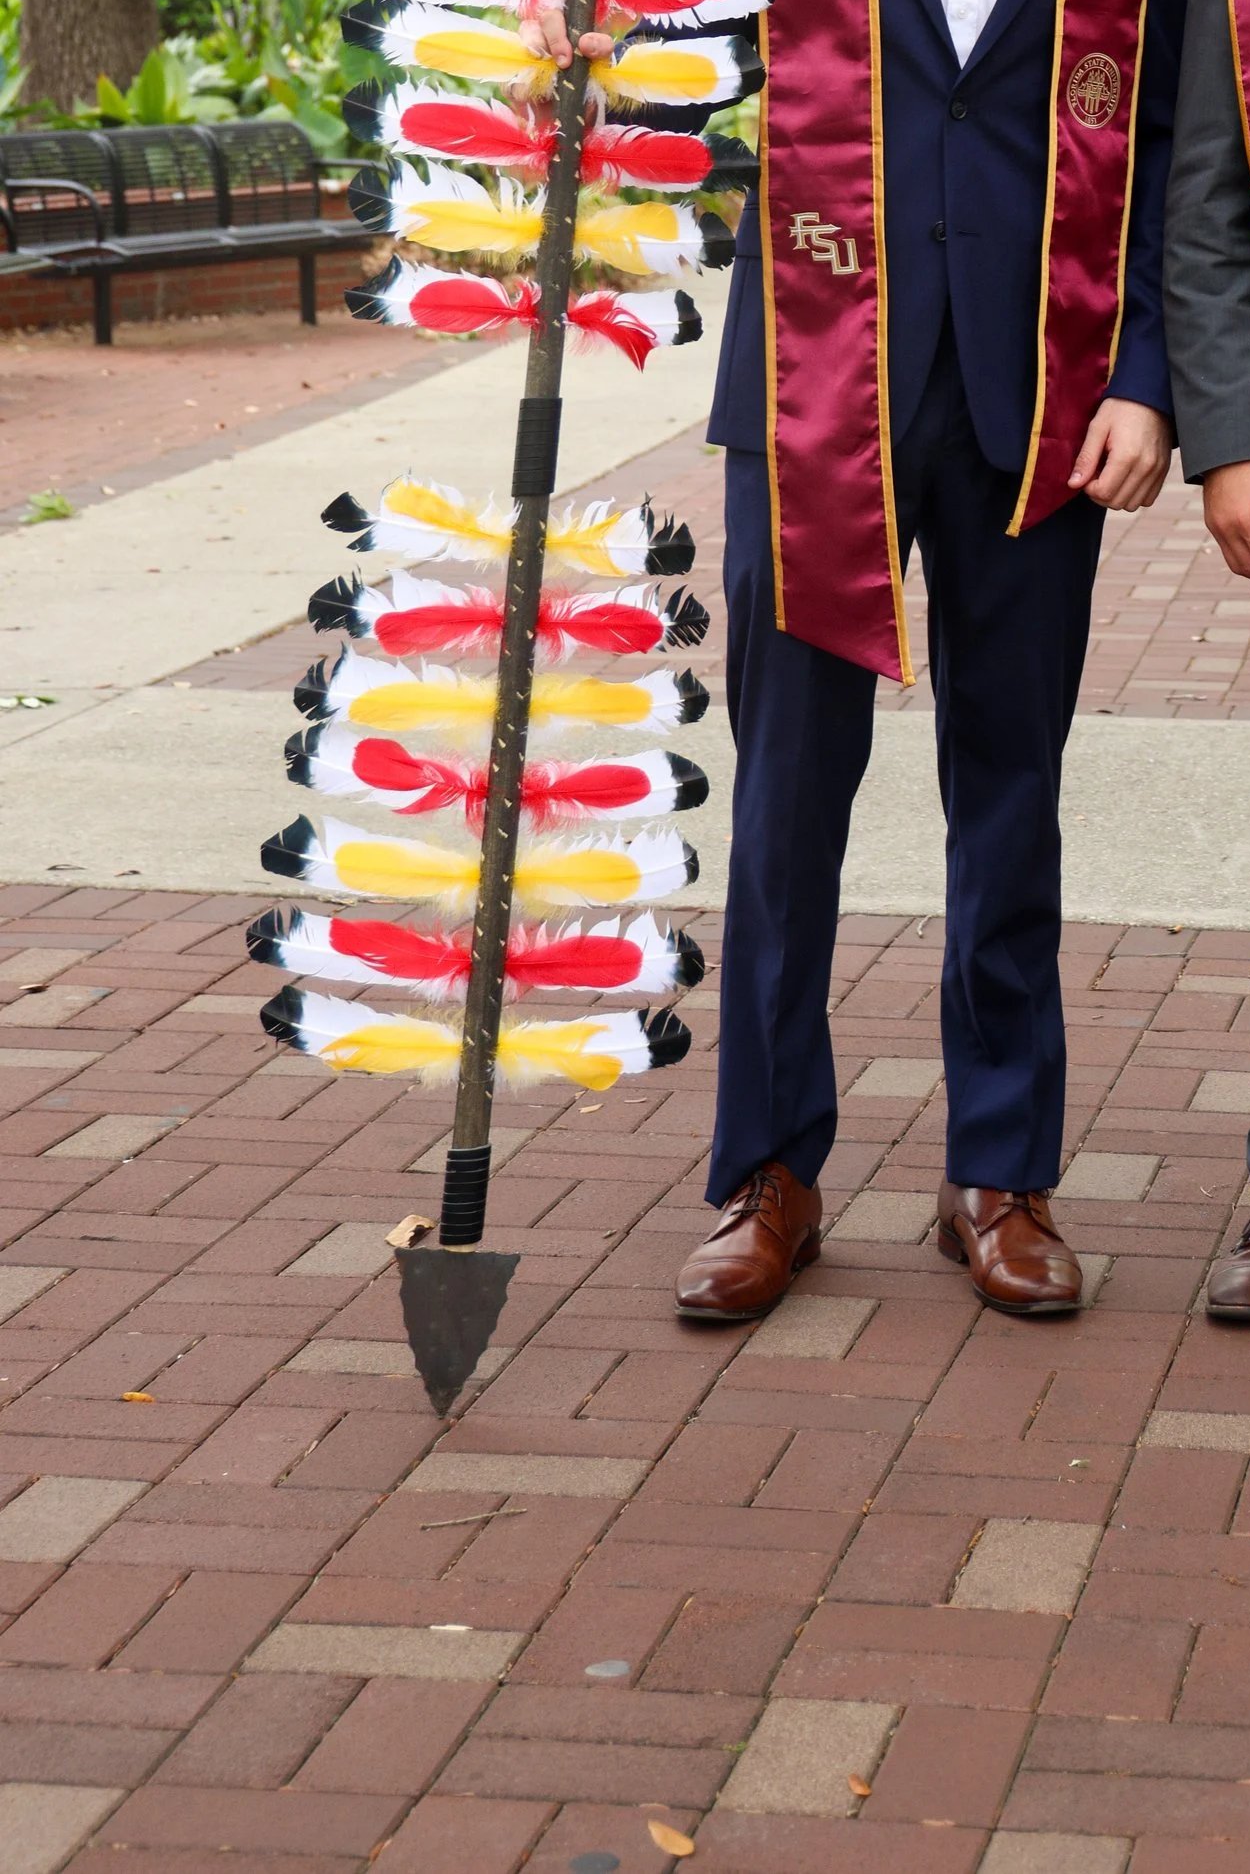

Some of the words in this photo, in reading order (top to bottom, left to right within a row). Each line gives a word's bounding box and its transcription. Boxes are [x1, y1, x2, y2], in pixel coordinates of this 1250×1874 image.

[1069, 68, 1084, 108] FLORIDA
[1084, 58, 1106, 68] STATE
[1104, 63, 1118, 114] UNIVERSITY
[788, 212, 863, 275] FSU
